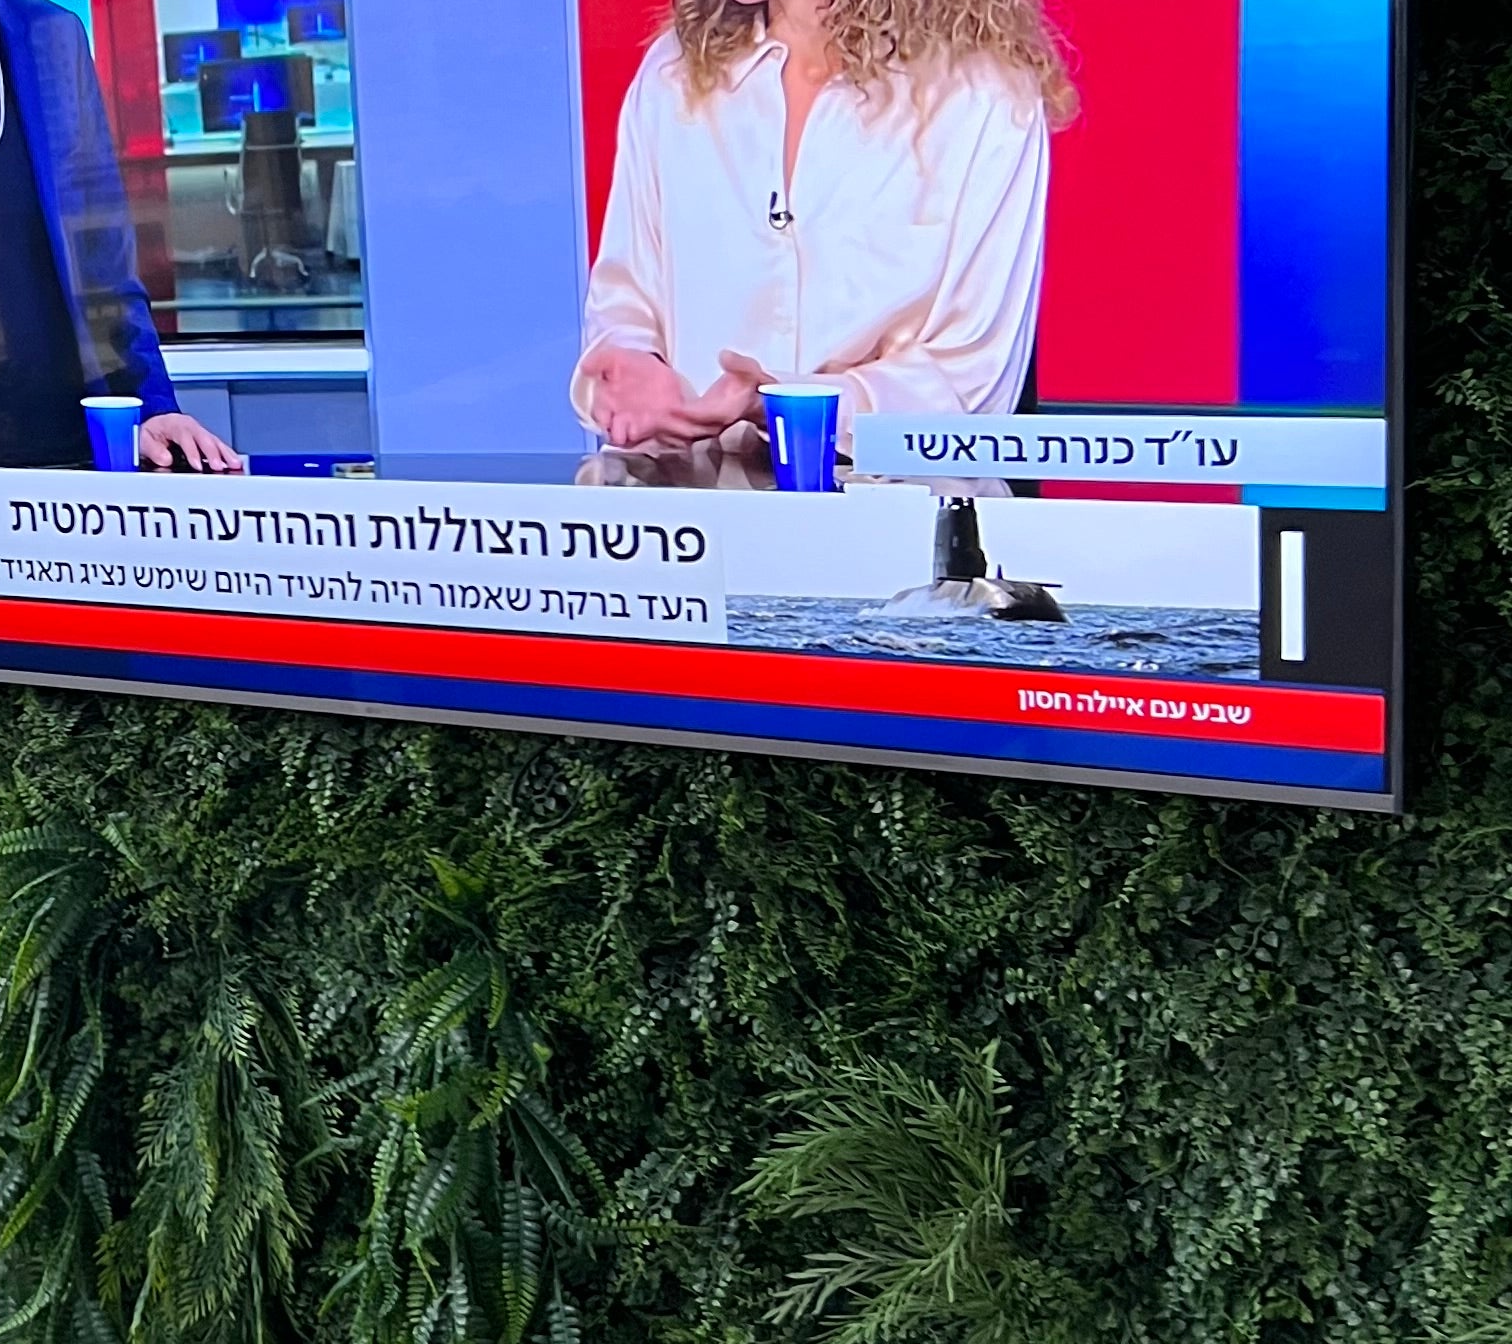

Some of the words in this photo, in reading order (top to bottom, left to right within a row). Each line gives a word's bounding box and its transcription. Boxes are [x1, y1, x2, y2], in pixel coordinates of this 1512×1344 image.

[903, 432, 1029, 463] בראשי
[1037, 434, 1136, 465] כנרת
[8, 499, 179, 539] הדרמטית
[187, 506, 358, 548] וההודעה
[367, 505, 549, 557] הצוללות
[560, 521, 706, 563] פרשת
[0, 557, 75, 584] תאגיד
[79, 562, 127, 587] נציג
[132, 564, 208, 592] שימש
[214, 569, 274, 597] היום
[277, 570, 363, 602] להעיד
[370, 579, 423, 606] היה
[428, 581, 532, 612] שאמור
[539, 588, 632, 620] ברקת
[637, 593, 709, 623] העד
[1017, 688, 1073, 712] חסון
[1076, 689, 1145, 718] איילה
[1149, 699, 1187, 720] עם
[1191, 701, 1252, 725] שבע
